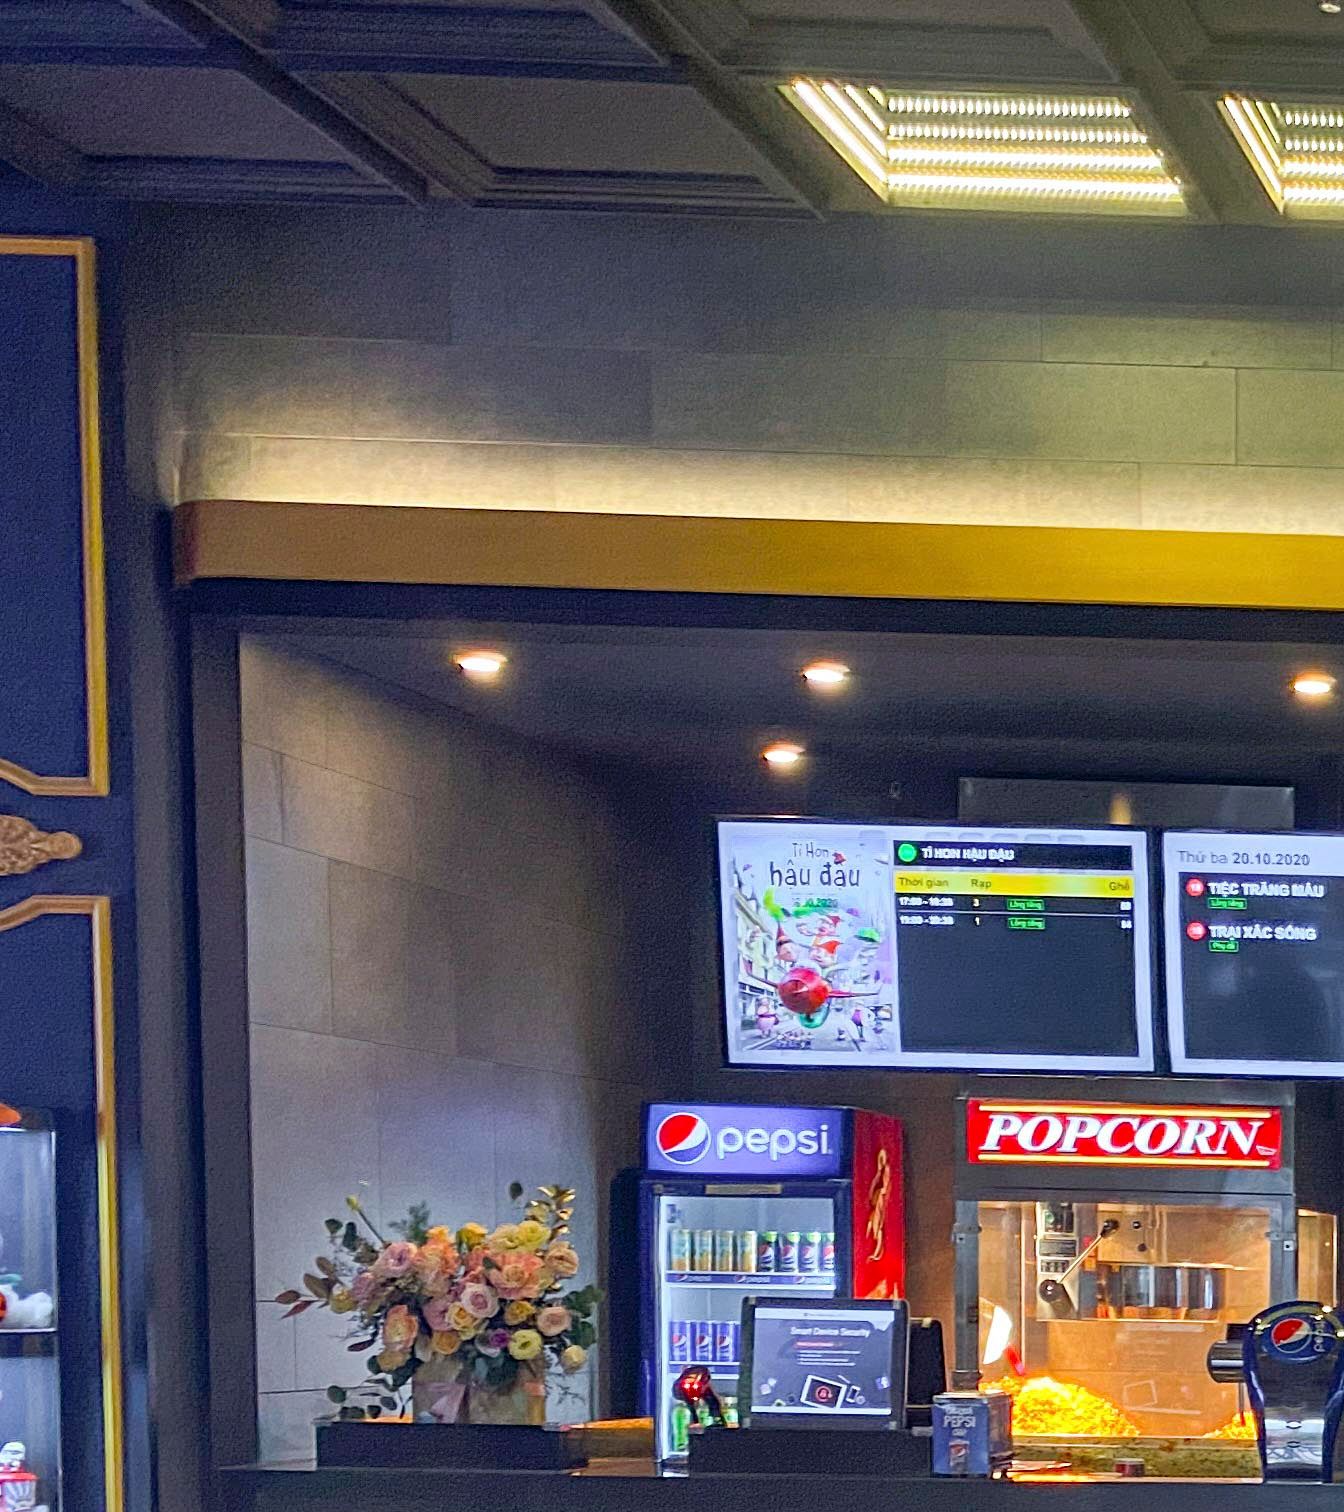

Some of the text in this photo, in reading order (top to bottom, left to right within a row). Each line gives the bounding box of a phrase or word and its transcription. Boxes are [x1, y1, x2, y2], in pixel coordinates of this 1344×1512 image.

[1232, 852, 1311, 866] 20.10.2020
[926, 878, 949, 890] gian
[979, 1113, 1264, 1155] POPCORN
[716, 1124, 829, 1161] pepsi
[943, 1415, 976, 1428] PEPSI
